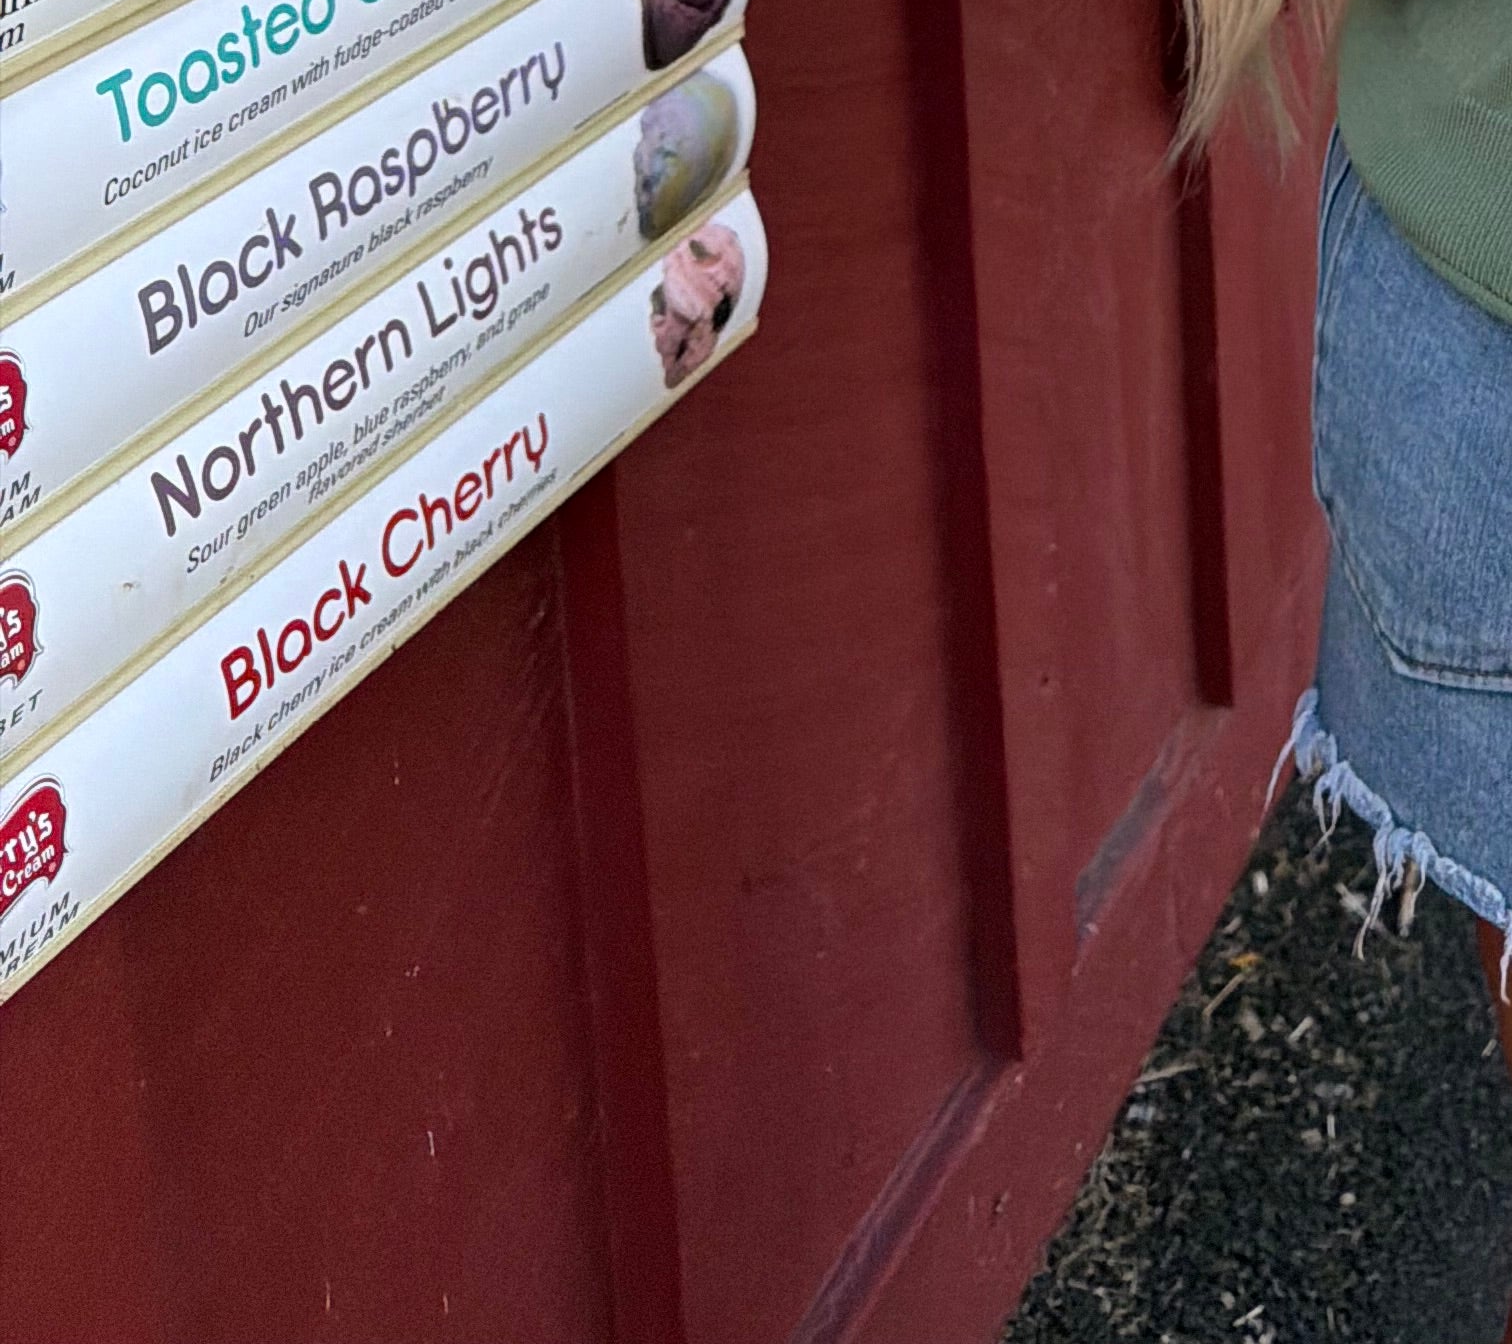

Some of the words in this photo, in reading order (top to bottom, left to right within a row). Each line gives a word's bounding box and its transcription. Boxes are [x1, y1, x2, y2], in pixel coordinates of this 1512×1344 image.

[137, 206, 303, 355] Black
[309, 40, 565, 240] Raspberry
[243, 296, 277, 338] Our
[280, 234, 364, 307] signature
[367, 206, 411, 255] black
[414, 157, 494, 228] raspberry
[148, 319, 411, 538] Northern
[417, 202, 564, 337] Lights
[185, 527, 235, 574] Sour
[238, 482, 292, 539] green
[295, 441, 349, 491] apple,
[353, 406, 389, 444] blue
[392, 344, 472, 414] raspberry,
[476, 312, 504, 351] and
[506, 282, 550, 330] grape
[220, 559, 373, 720] Black
[380, 412, 549, 578] Cherry
